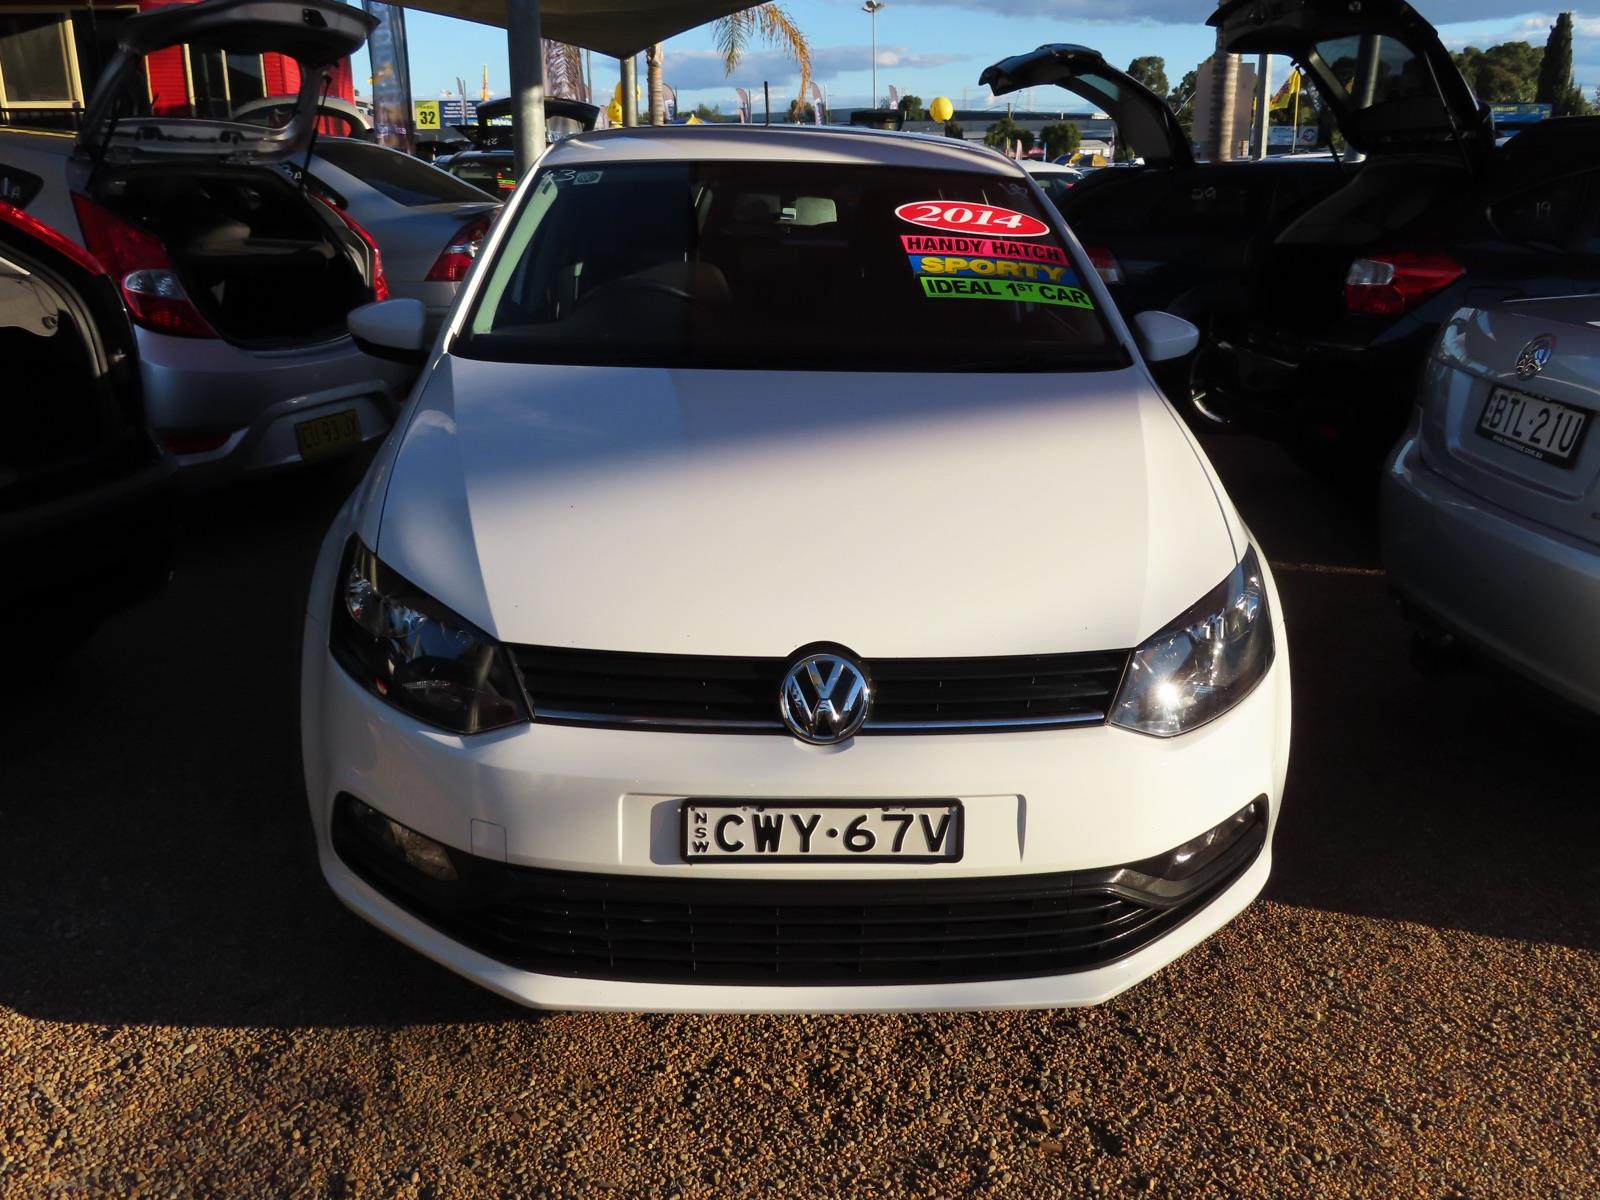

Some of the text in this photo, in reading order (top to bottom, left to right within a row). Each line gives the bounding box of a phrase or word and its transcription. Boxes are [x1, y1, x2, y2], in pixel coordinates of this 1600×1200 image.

[420, 111, 436, 125] 32
[911, 205, 1022, 229] 2014
[907, 237, 1060, 263] HANDY HATCH
[920, 257, 1065, 281] SPORTY
[927, 279, 1002, 296] IDEAL
[1038, 286, 1091, 306] CAR
